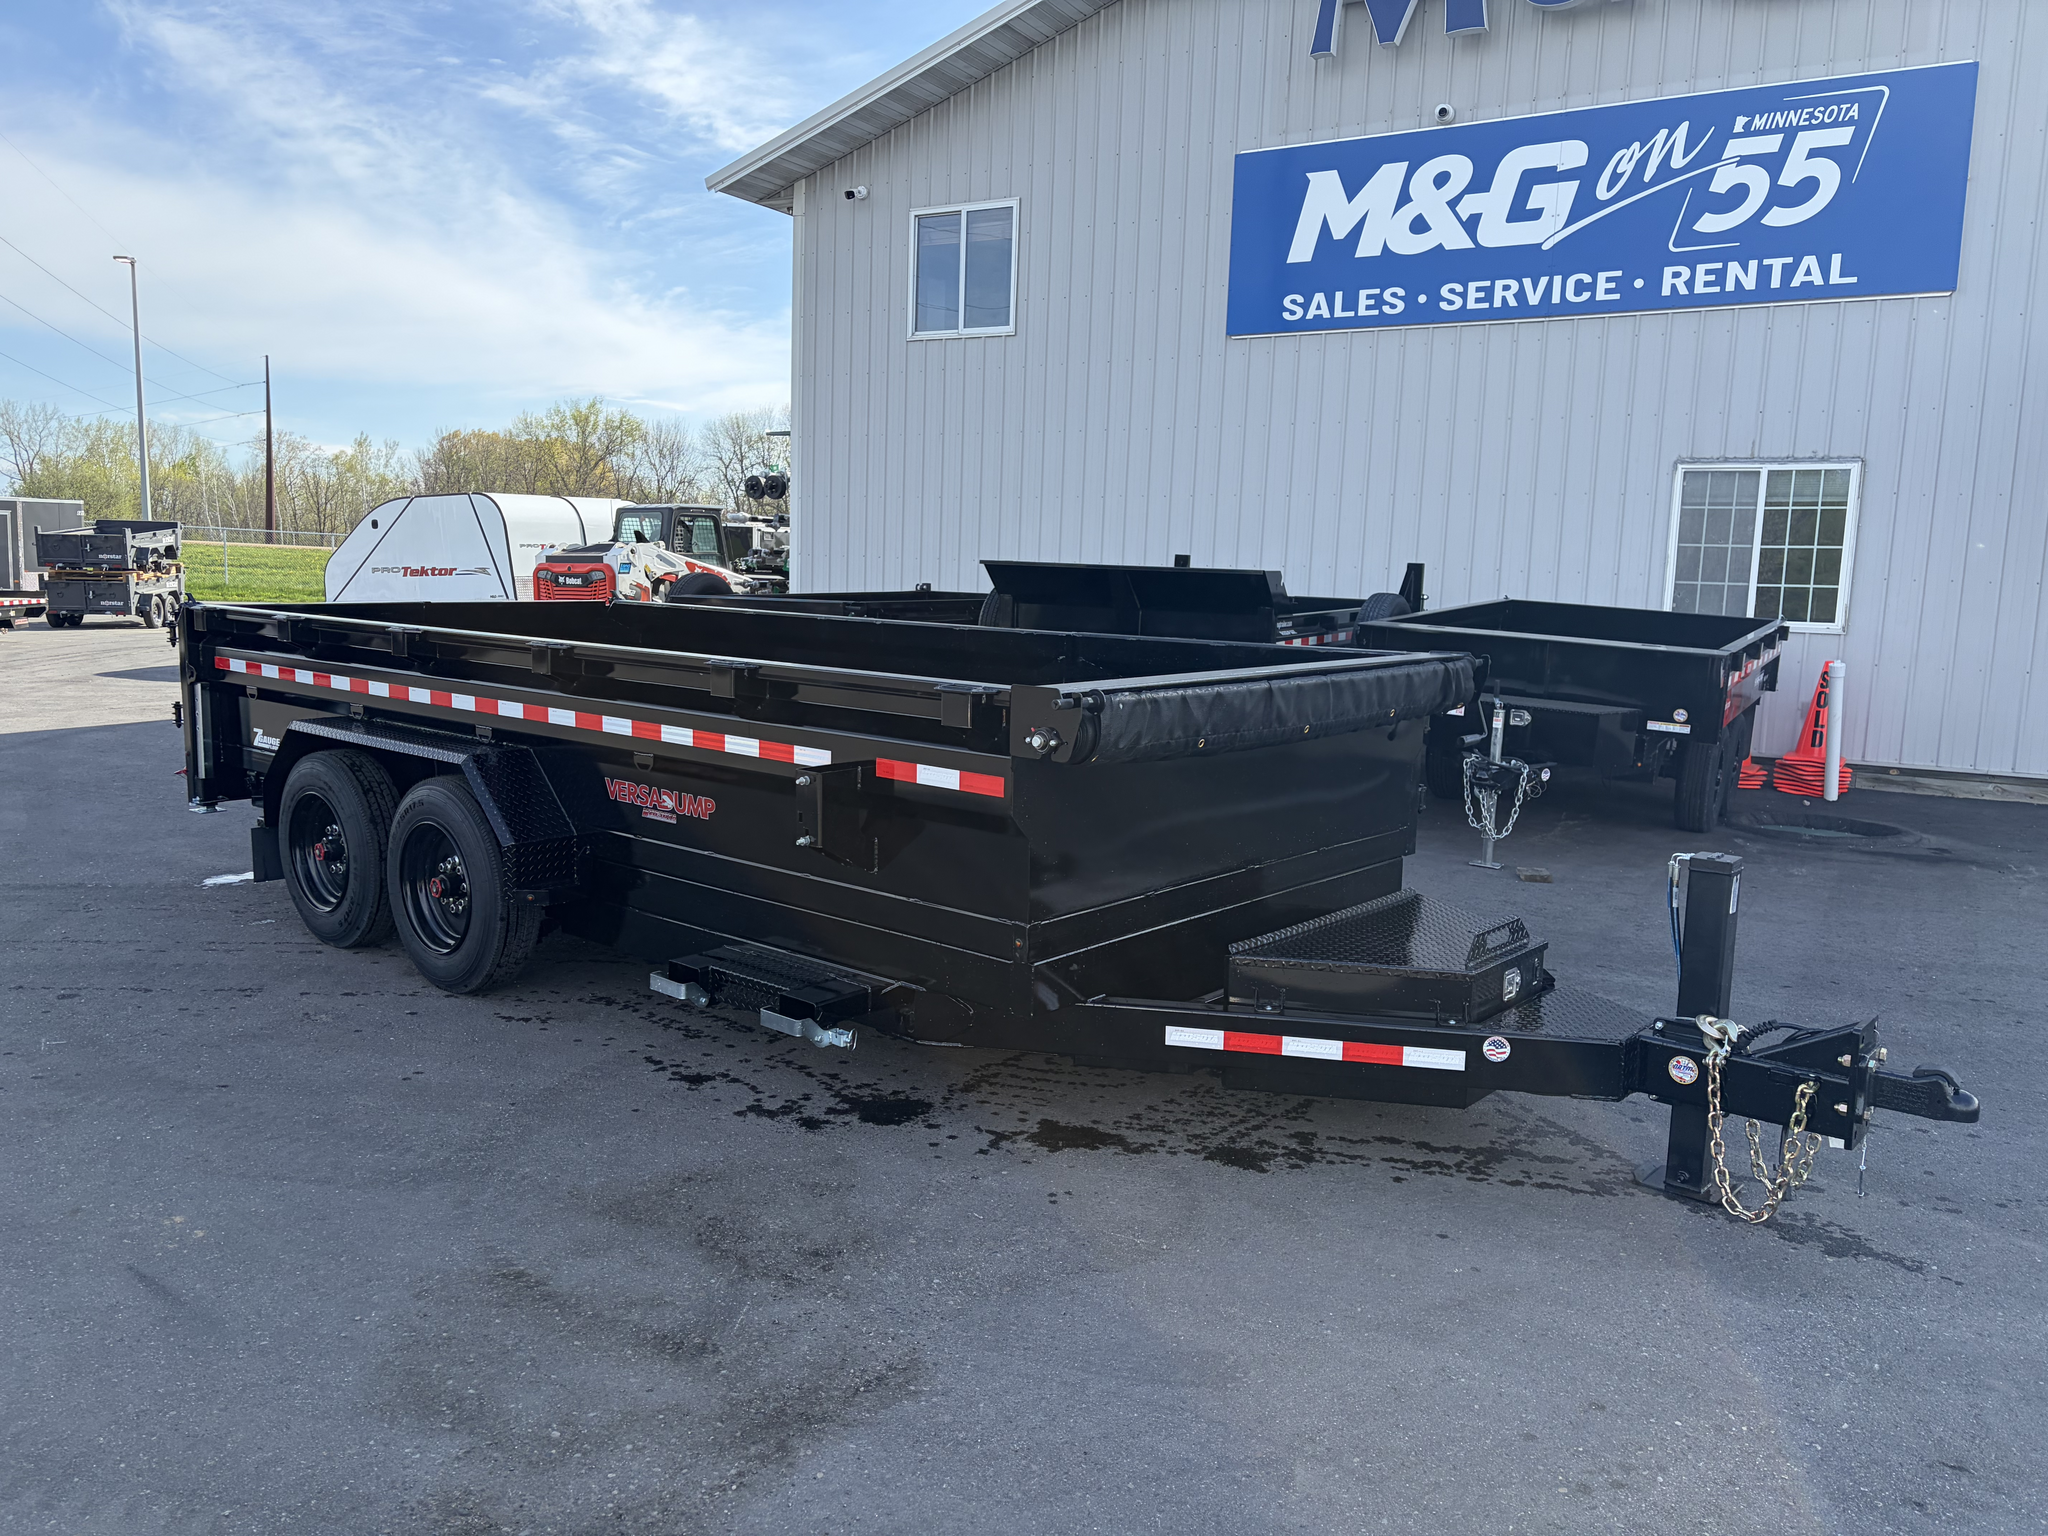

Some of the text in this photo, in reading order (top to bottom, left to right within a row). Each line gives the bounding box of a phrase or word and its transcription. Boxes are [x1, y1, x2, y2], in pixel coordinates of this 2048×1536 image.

[1750, 102, 1859, 132] MINNESOTA
[1286, 121, 1856, 264] M&G on 55
[1282, 252, 1858, 321] SALES SERVICE RENTAL
[1810, 671, 1830, 748] SOLD
[253, 727, 264, 746] 7
[258, 735, 281, 747] GAUGE
[604, 776, 716, 820] VERSADUMP
